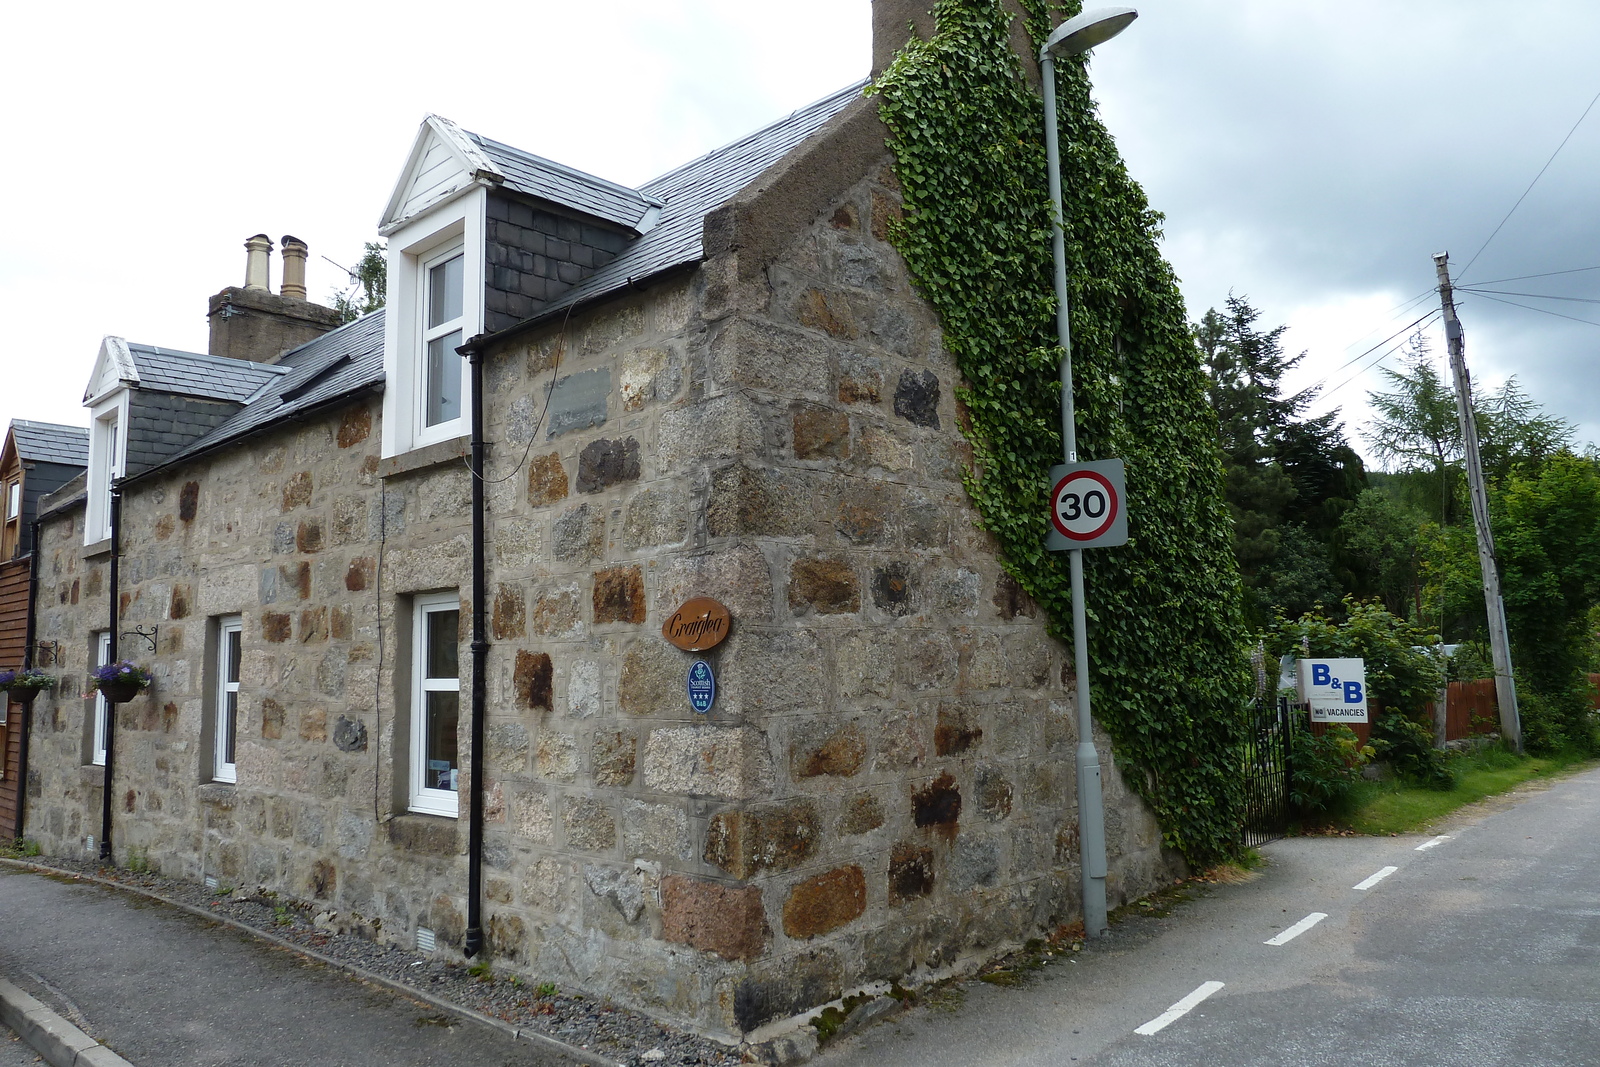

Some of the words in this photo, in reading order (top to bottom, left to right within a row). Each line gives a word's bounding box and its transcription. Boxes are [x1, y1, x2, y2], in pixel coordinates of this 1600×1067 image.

[1070, 452, 1075, 460] 1
[1060, 490, 1106, 520] 30
[690, 678, 711, 686] Scottish
[1312, 664, 1363, 703] B&B
[1327, 708, 1365, 716] VACANCIES
